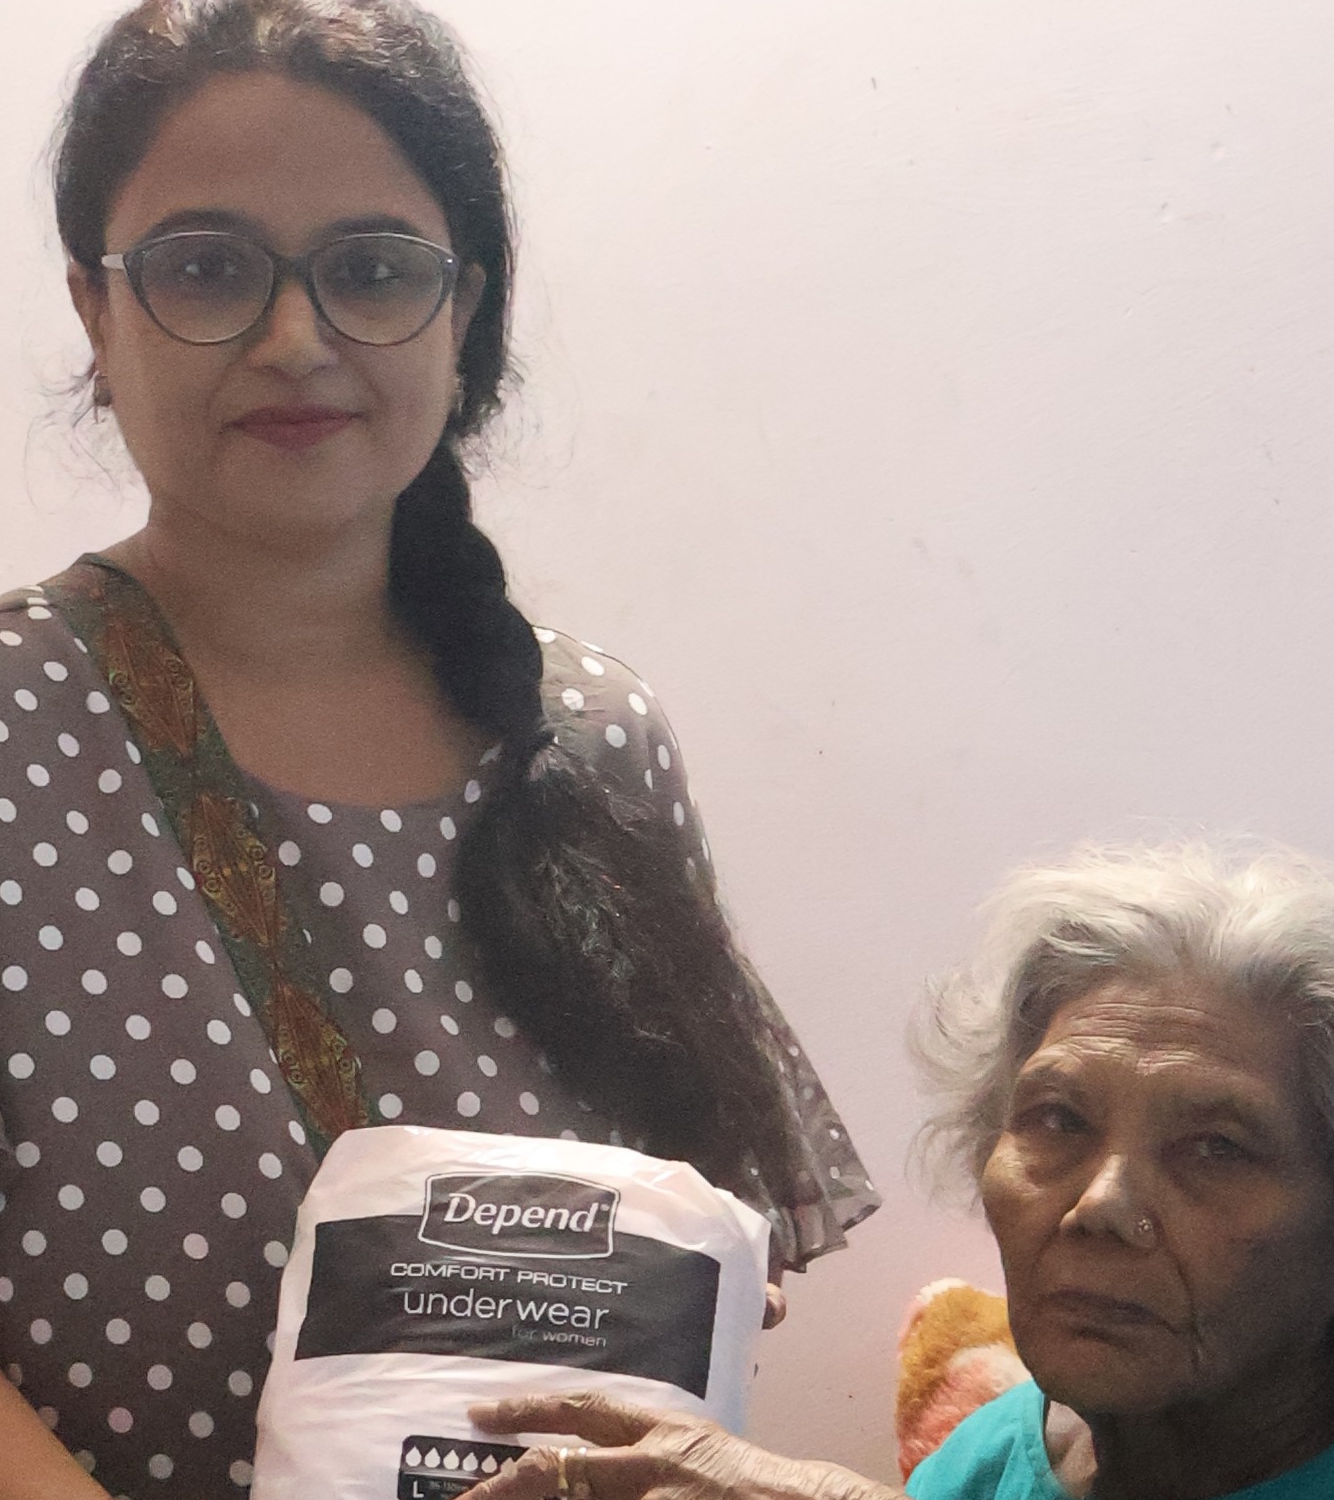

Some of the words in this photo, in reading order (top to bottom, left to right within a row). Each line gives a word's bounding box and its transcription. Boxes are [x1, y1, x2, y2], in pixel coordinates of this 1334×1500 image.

[444, 1193, 599, 1235] Depend
[391, 1263, 509, 1281] COMFORT
[518, 1271, 628, 1294] PROTECT
[404, 1288, 609, 1329] underwear
[543, 1331, 606, 1347] women
[412, 1481, 424, 1498] L
